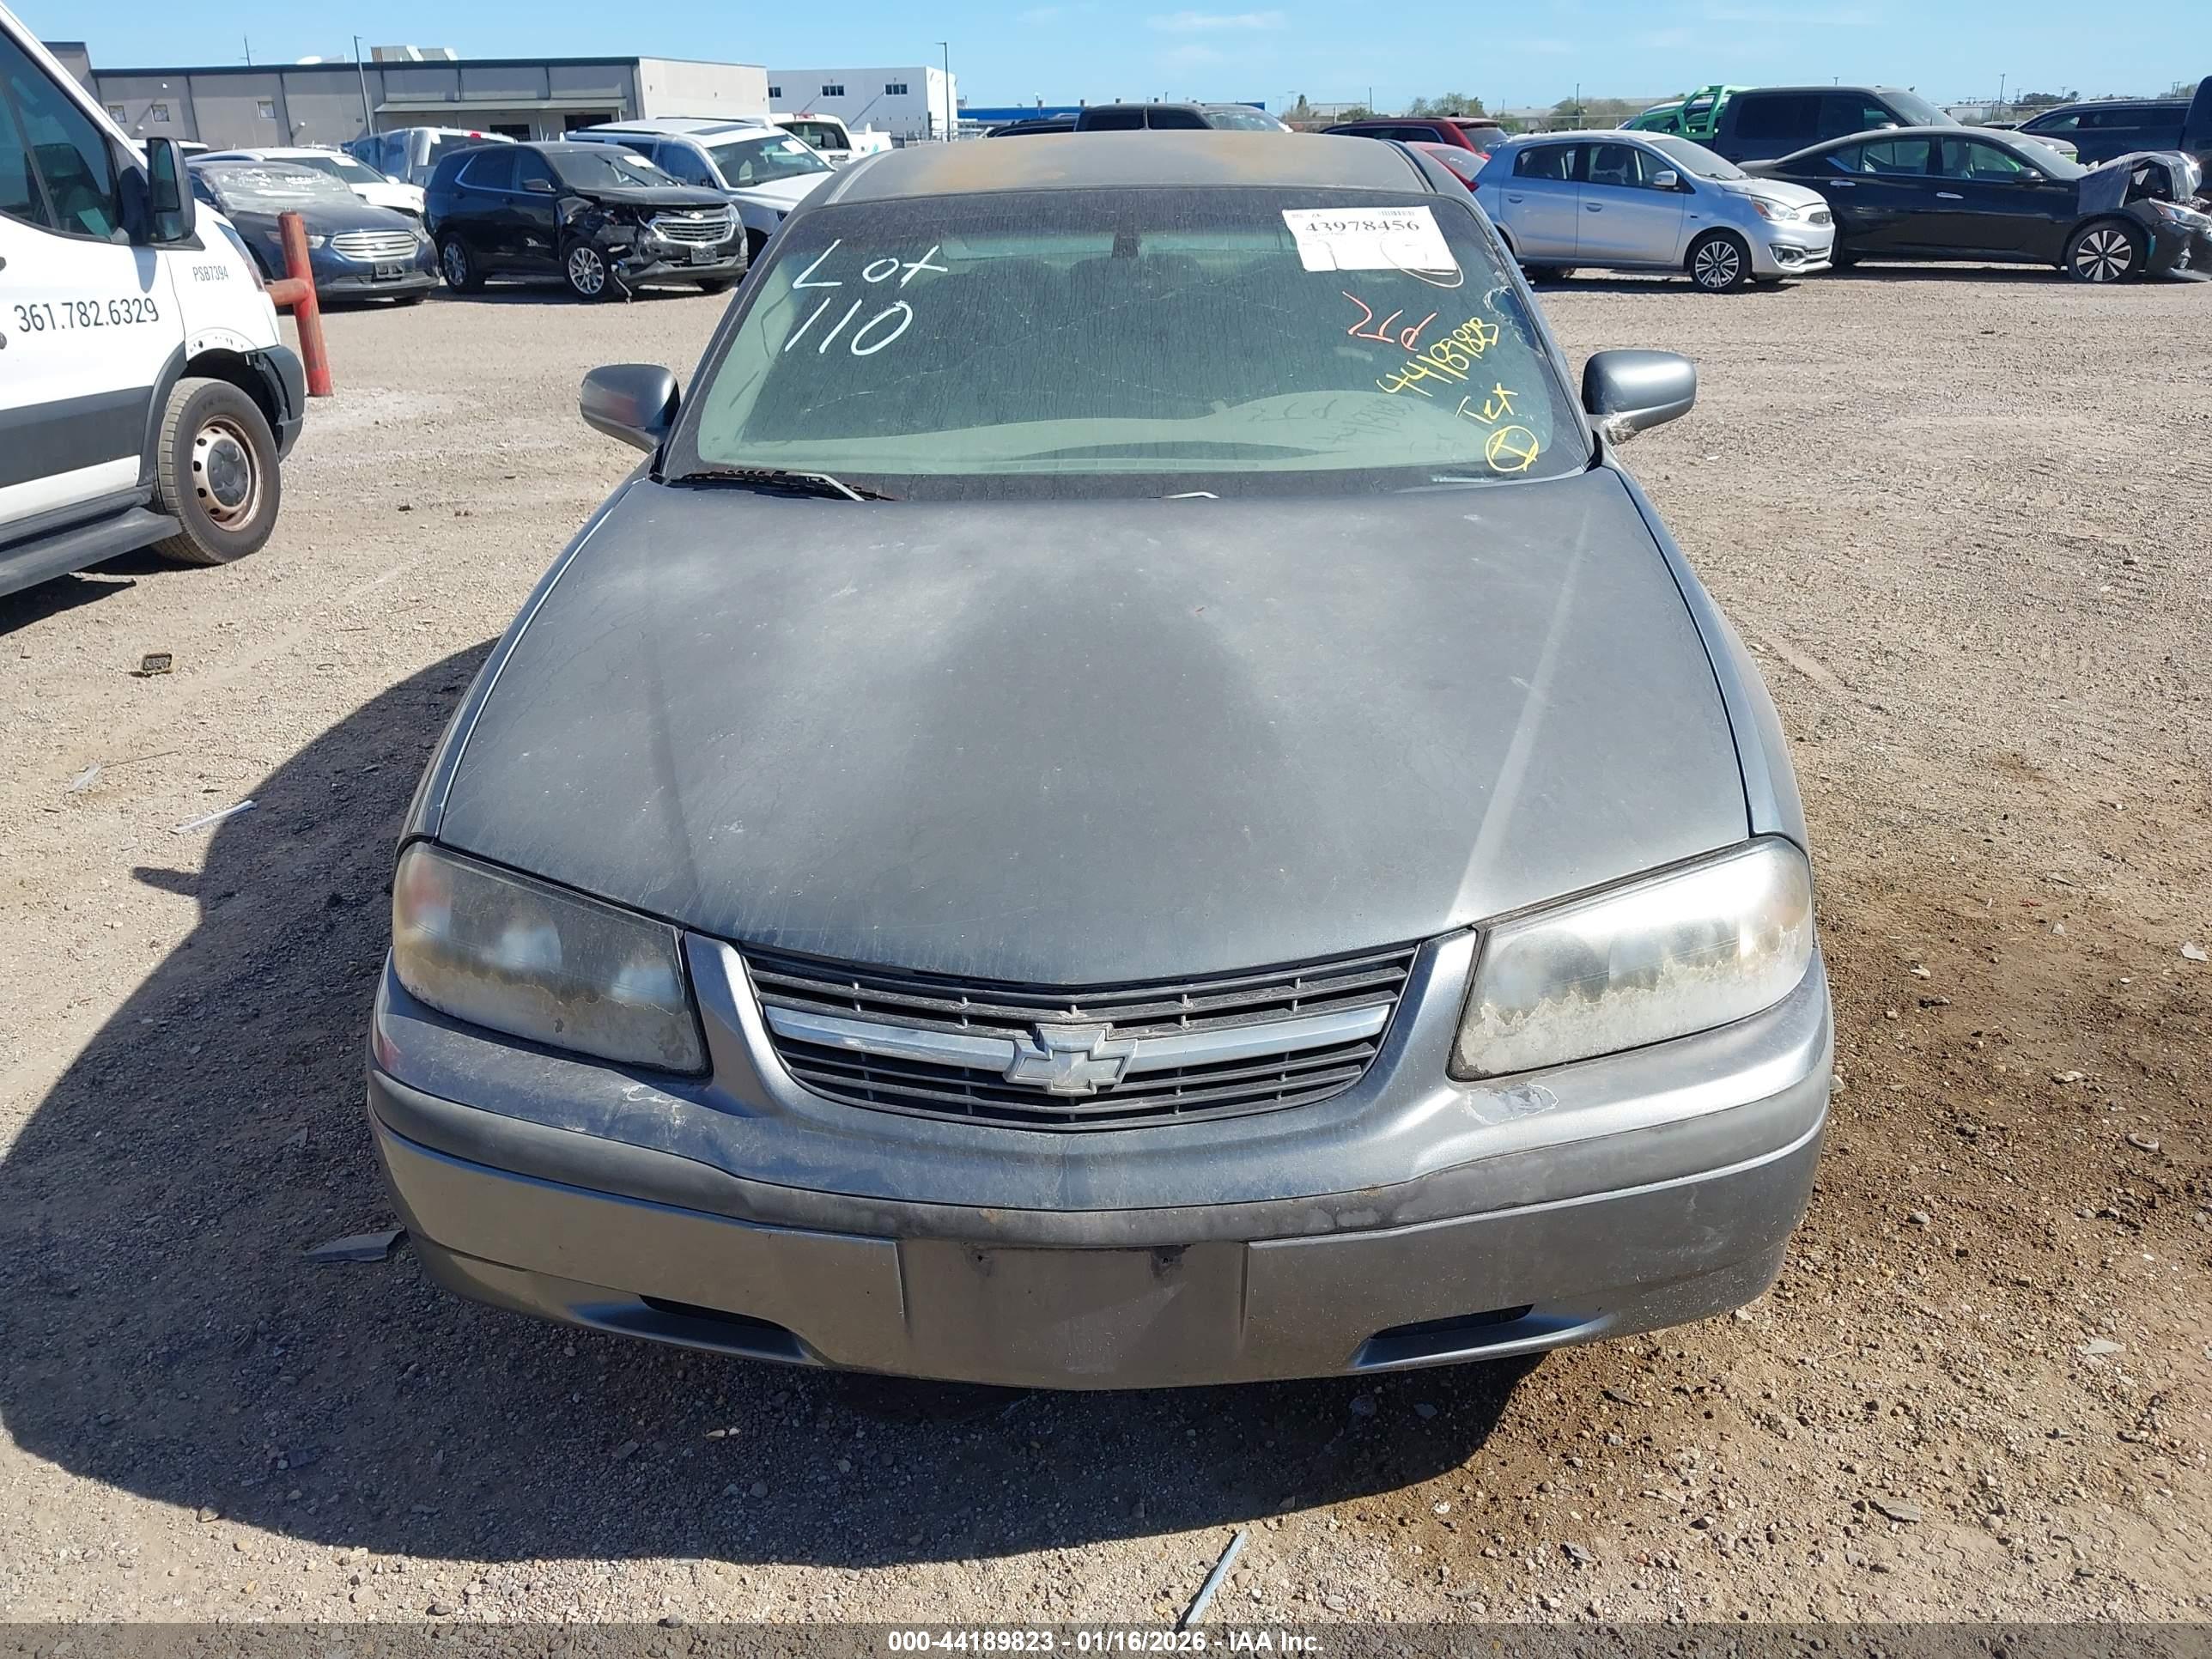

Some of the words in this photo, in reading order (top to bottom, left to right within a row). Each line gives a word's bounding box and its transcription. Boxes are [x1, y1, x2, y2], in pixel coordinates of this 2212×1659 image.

[1305, 220, 1420, 232] 43978456
[191, 264, 229, 283] PSB7394
[14, 297, 160, 333] 361.782.6329
[784, 298, 914, 356] 110
[1376, 316, 1500, 398] 44189823
